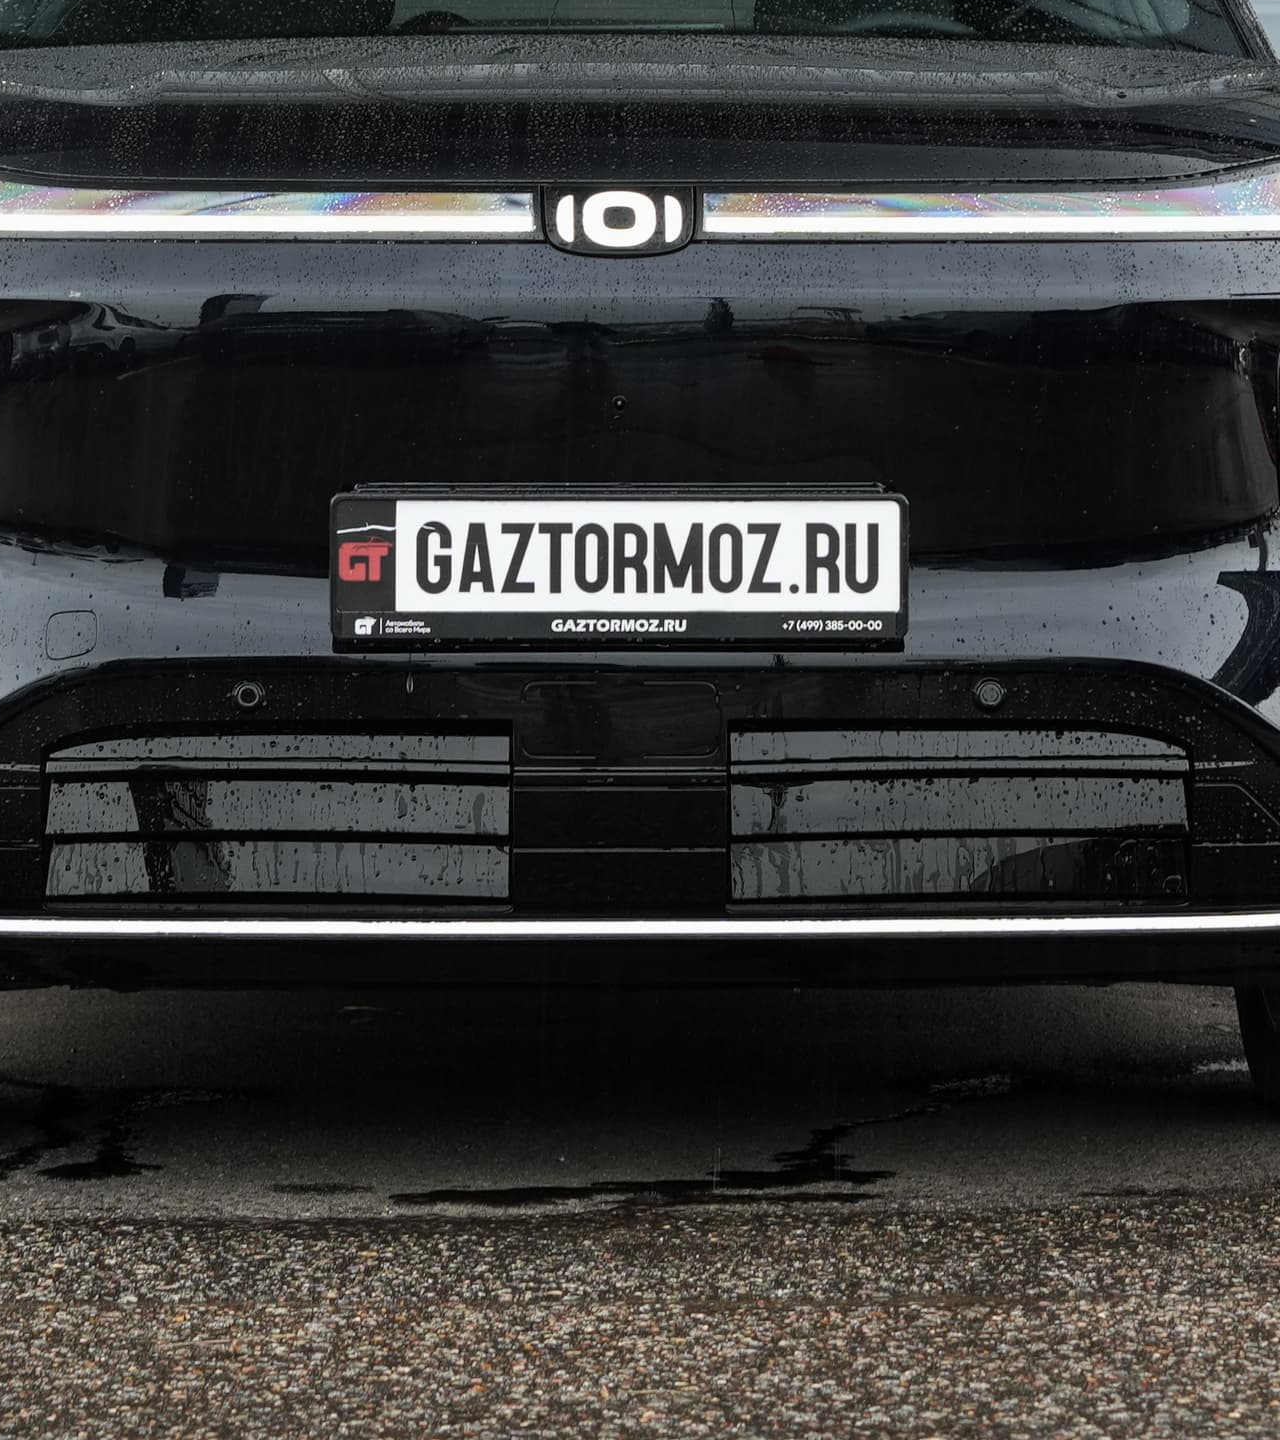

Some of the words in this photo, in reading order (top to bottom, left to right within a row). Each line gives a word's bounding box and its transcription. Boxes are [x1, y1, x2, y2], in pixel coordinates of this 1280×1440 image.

[338, 539, 392, 582] GT
[416, 520, 879, 595] GAZTORMOZ.RU
[551, 619, 688, 632] GAZTORMOZ.RU
[782, 620, 795, 631] +7
[796, 619, 823, 632] (499)
[825, 620, 882, 631] 385-00-00
